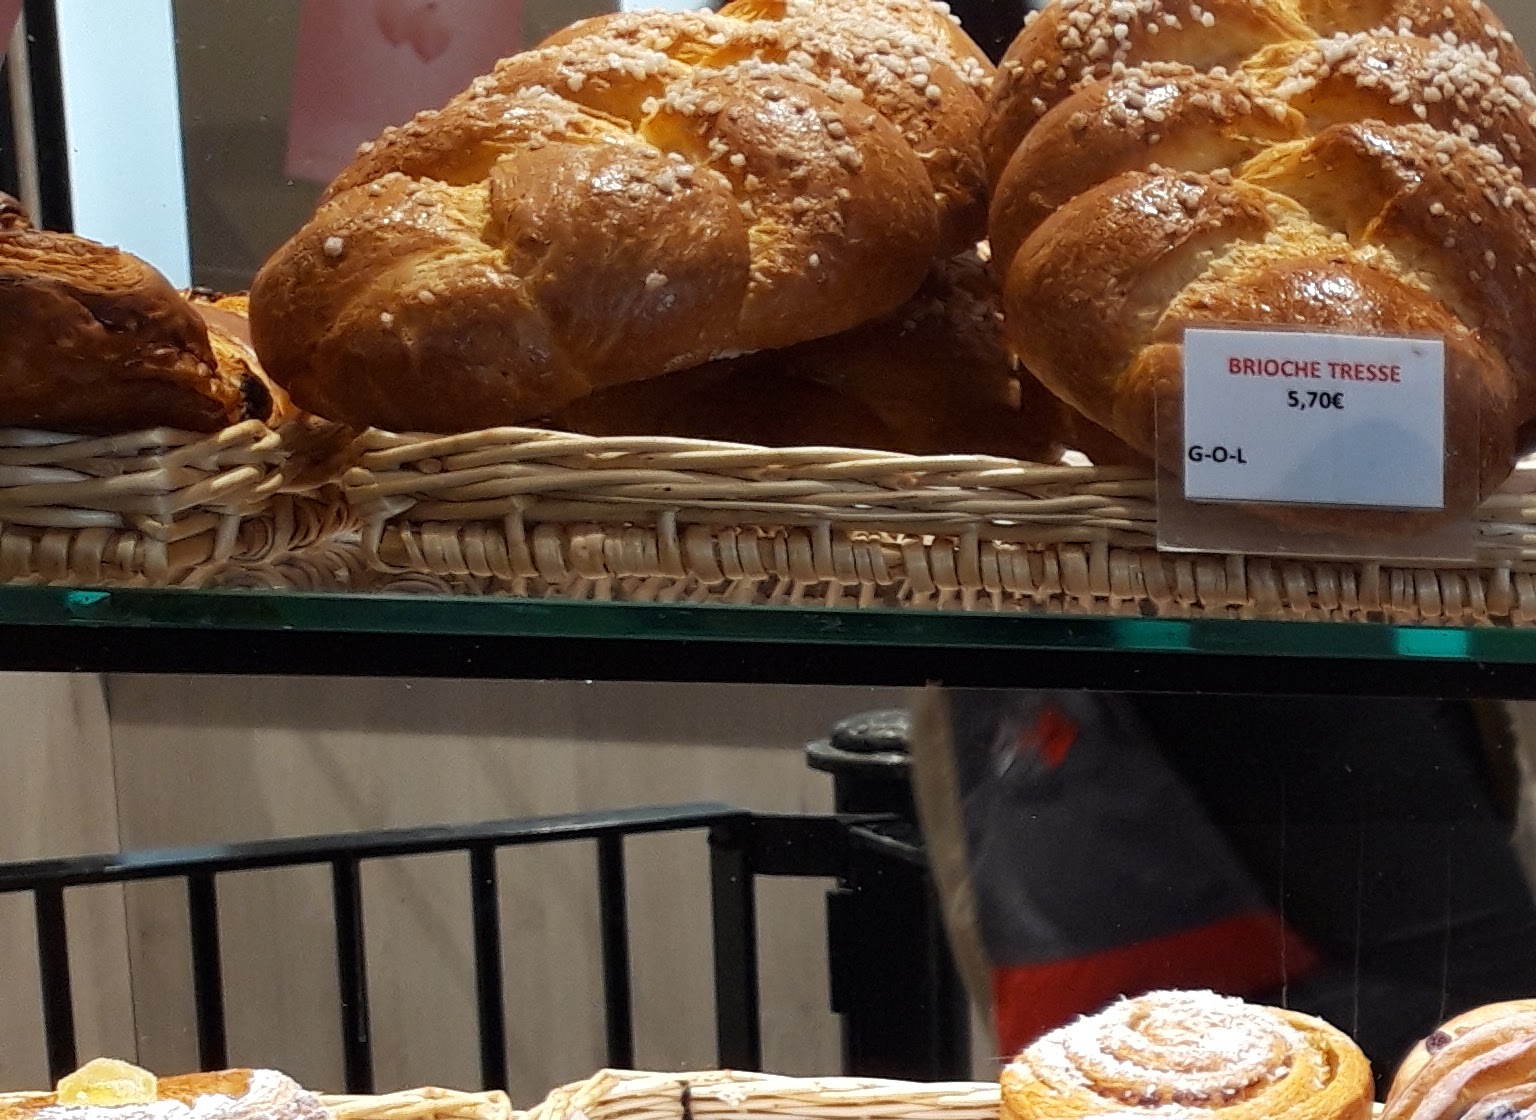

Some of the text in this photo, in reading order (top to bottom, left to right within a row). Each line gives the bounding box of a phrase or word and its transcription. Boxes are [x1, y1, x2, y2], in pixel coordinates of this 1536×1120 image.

[1228, 357, 1402, 383] BRIOCHE TRESSE
[1287, 390, 1345, 411] 5,70€
[1188, 445, 1247, 464] G-O-L
